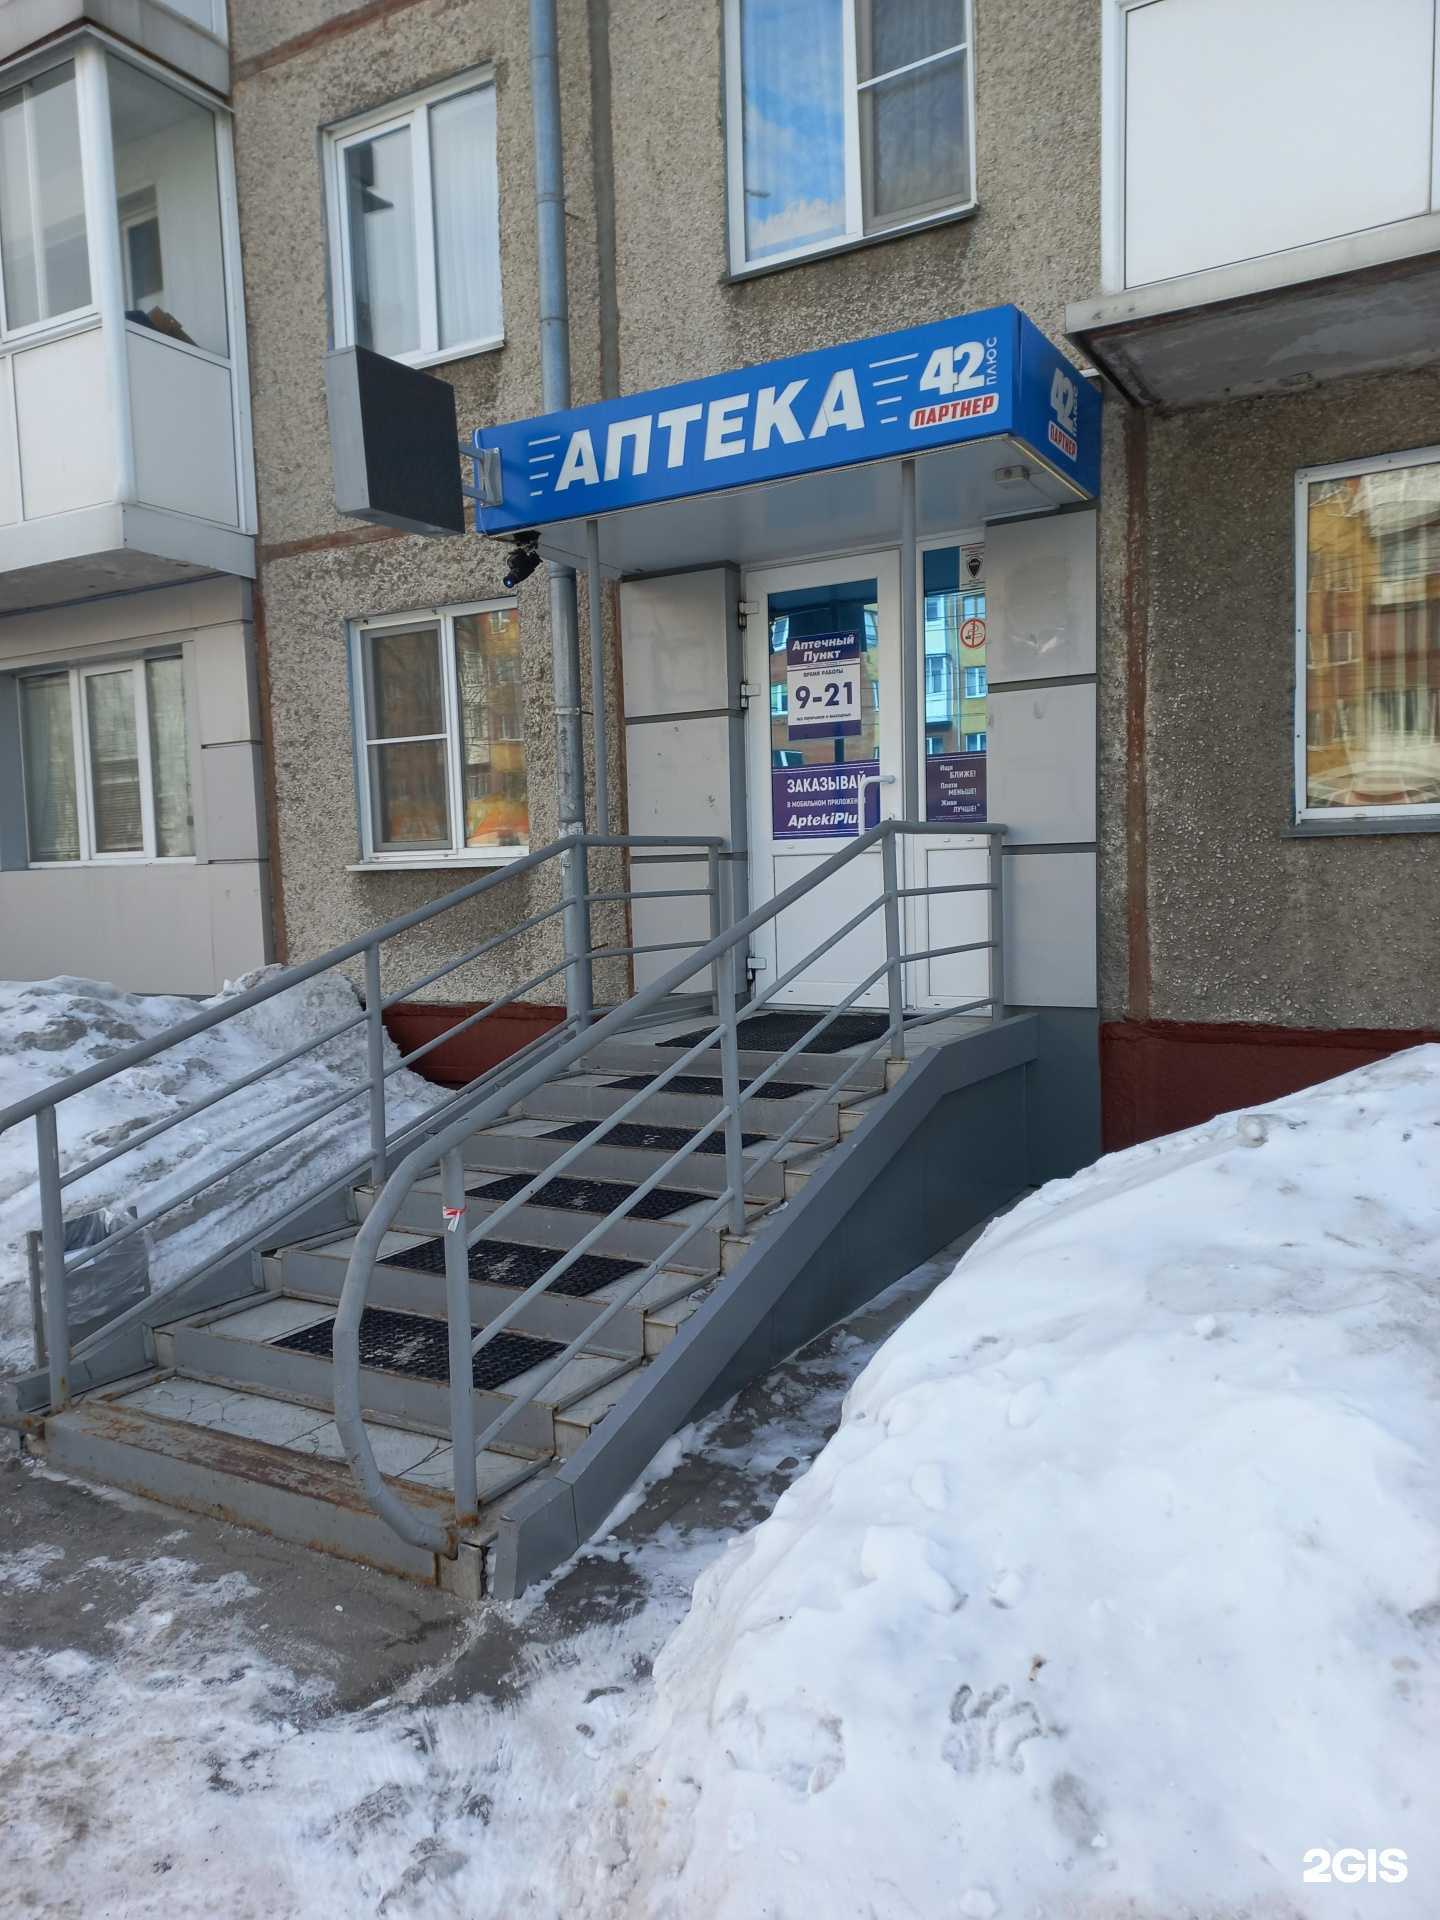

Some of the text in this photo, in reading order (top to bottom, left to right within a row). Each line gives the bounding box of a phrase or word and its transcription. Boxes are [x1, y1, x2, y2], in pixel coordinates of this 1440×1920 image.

[920, 341, 985, 395] 42
[986, 336, 998, 385] ПЛЮС
[914, 396, 994, 427] ПАРТНЕР
[1050, 368, 1075, 432] 42
[554, 368, 865, 491] АПТЕКА
[1050, 425, 1076, 456] ПАРТНЕР
[792, 634, 855, 651] Аптечный
[803, 650, 841, 663] Пункт
[795, 681, 853, 709] 9-21
[787, 770, 866, 793] ЗАКАЗЫВАЙ
[950, 769, 977, 779] БЛИЖЕ!
[792, 799, 826, 808] МОБИЛЬНОМ
[788, 812, 861, 828] AptekiPlu
